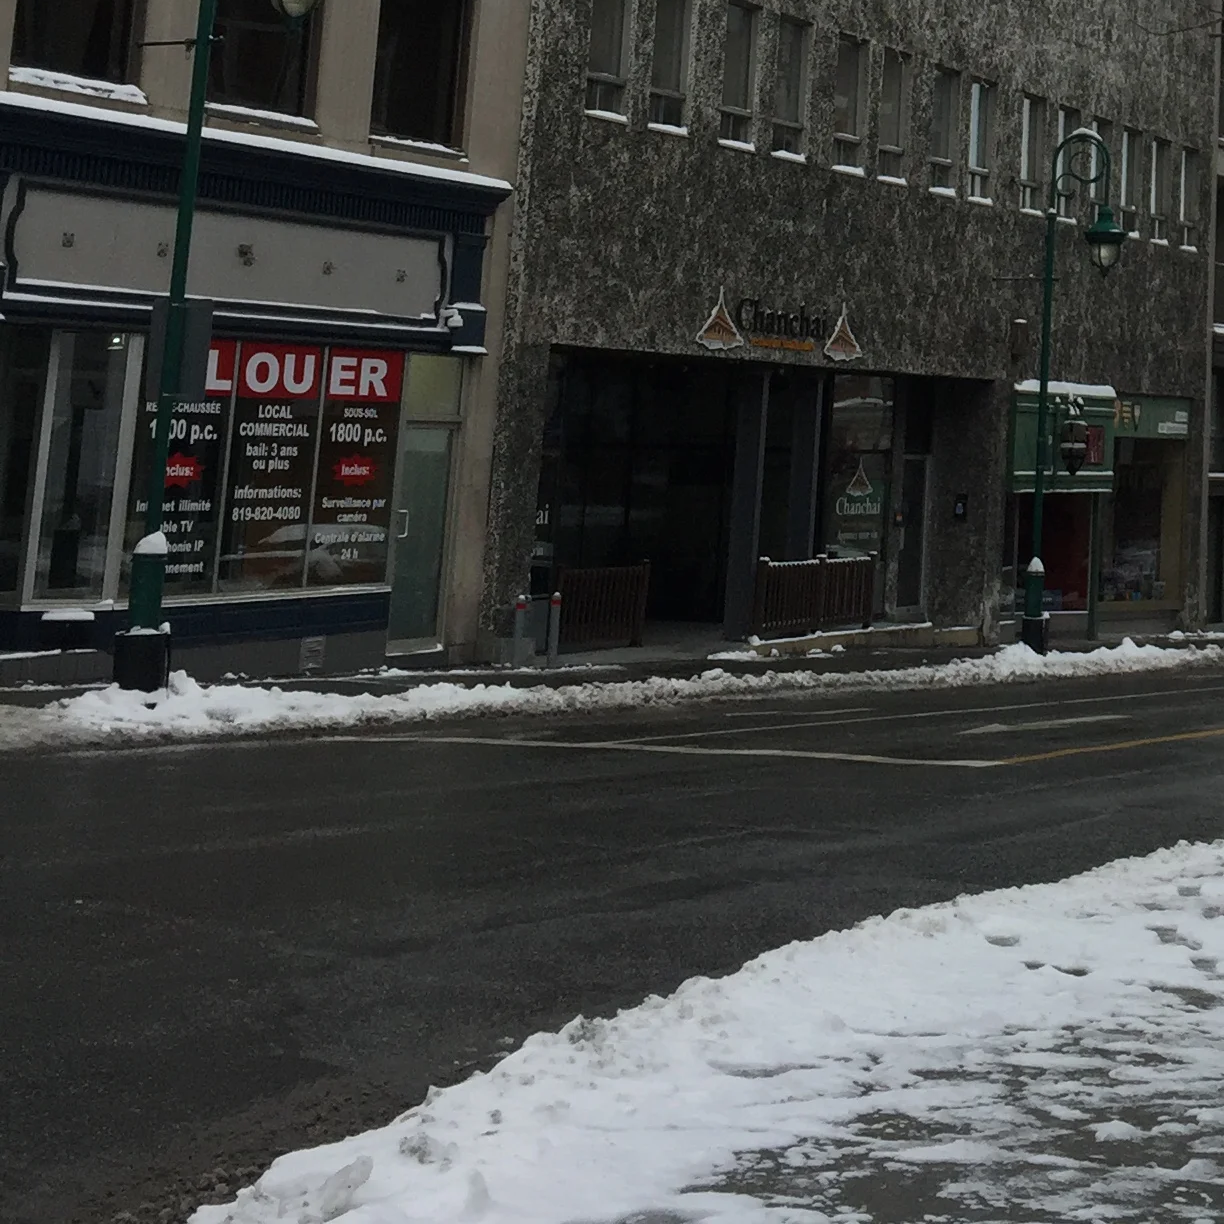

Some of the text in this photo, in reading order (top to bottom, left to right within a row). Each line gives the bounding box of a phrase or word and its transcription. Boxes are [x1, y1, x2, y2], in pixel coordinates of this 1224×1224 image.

[736, 298, 827, 339] Chanchai
[205, 349, 388, 397] LOUER
[258, 404, 293, 419] LOCAL
[344, 407, 378, 419] SOUS-SOL
[149, 419, 218, 445] 100 p.c.
[239, 423, 309, 437] COMMERCIAL
[330, 422, 387, 448] 1800 p.c.
[246, 443, 298, 457] bail: 3 ans
[253, 457, 290, 473] ou plus
[234, 485, 302, 499] informations:
[321, 497, 371, 508] Surveillance
[835, 497, 880, 516] Chanchai
[232, 506, 301, 521] 819-820-4080
[336, 511, 367, 522] caméra
[180, 520, 194, 532] TV
[341, 548, 352, 560] 24
